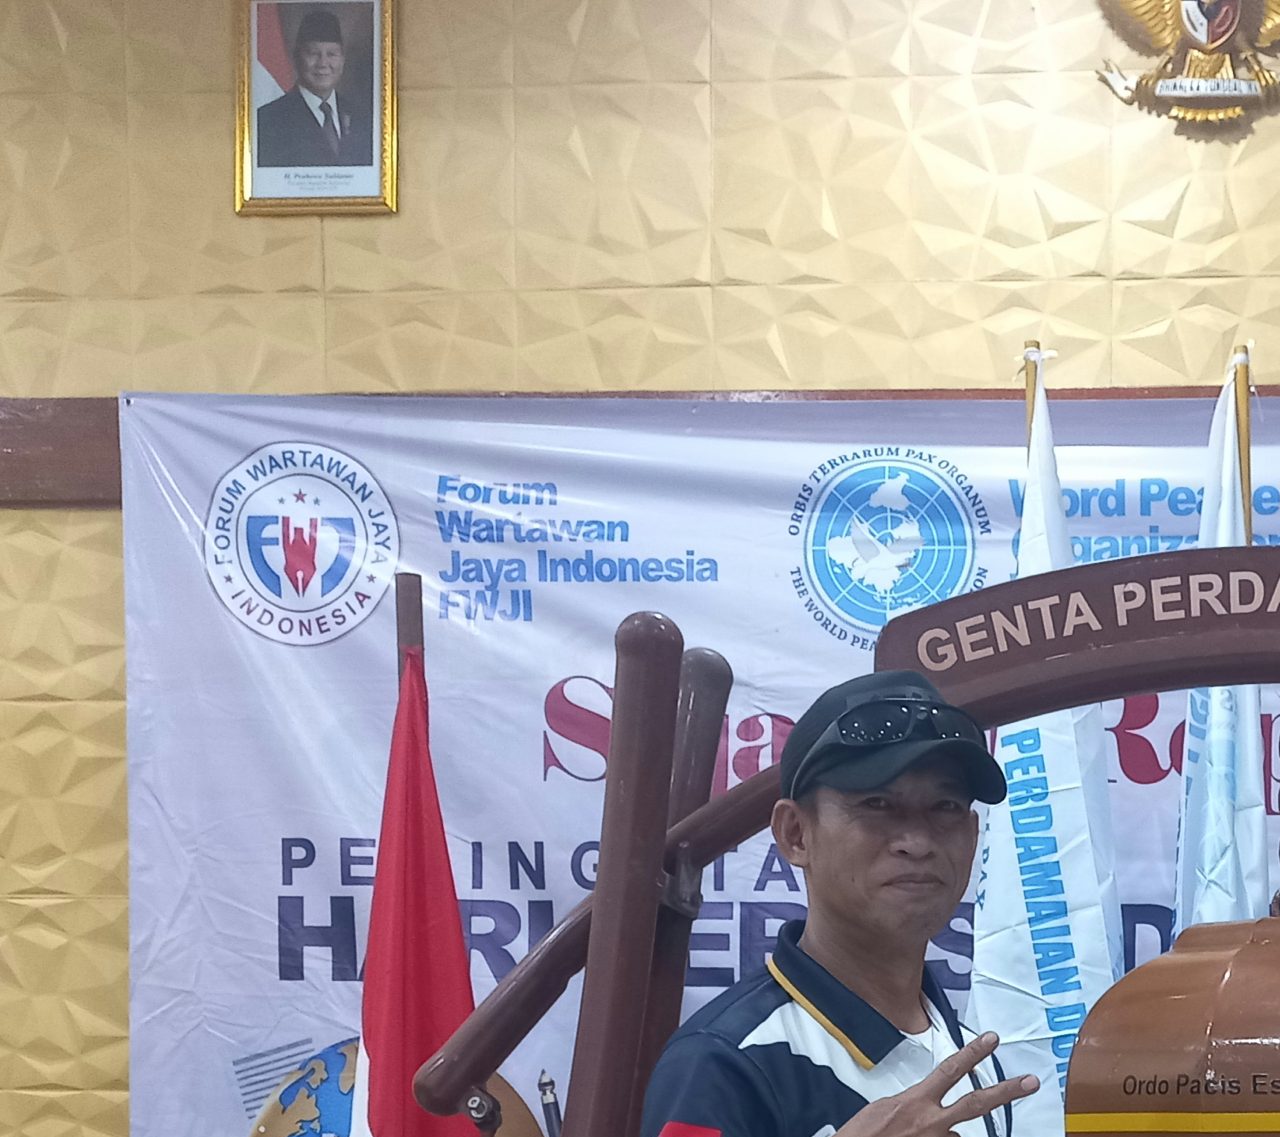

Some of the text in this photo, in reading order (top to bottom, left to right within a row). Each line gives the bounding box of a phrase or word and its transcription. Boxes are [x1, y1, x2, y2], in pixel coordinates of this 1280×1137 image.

[214, 450, 391, 566] FORUM WARTAWAN JAYA
[437, 474, 557, 506] Forum
[788, 447, 992, 536] ORBIS TERRARUM PAX ORGANUM
[1008, 478, 1280, 518] ord Pee
[435, 510, 629, 544] Wartawan
[439, 551, 718, 585] Jaya Indonesia
[231, 589, 371, 636] INDONESIA
[439, 591, 533, 622] FWJI
[790, 567, 876, 652] THE WORLD PEA
[917, 591, 1102, 673] GENTA
[281, 837, 800, 892] PEINGTA
[1001, 728, 1082, 996] PERDAMAIAN
[1123, 1075, 1168, 1095] Ordo
[1176, 1074, 1241, 1096] Pacis
